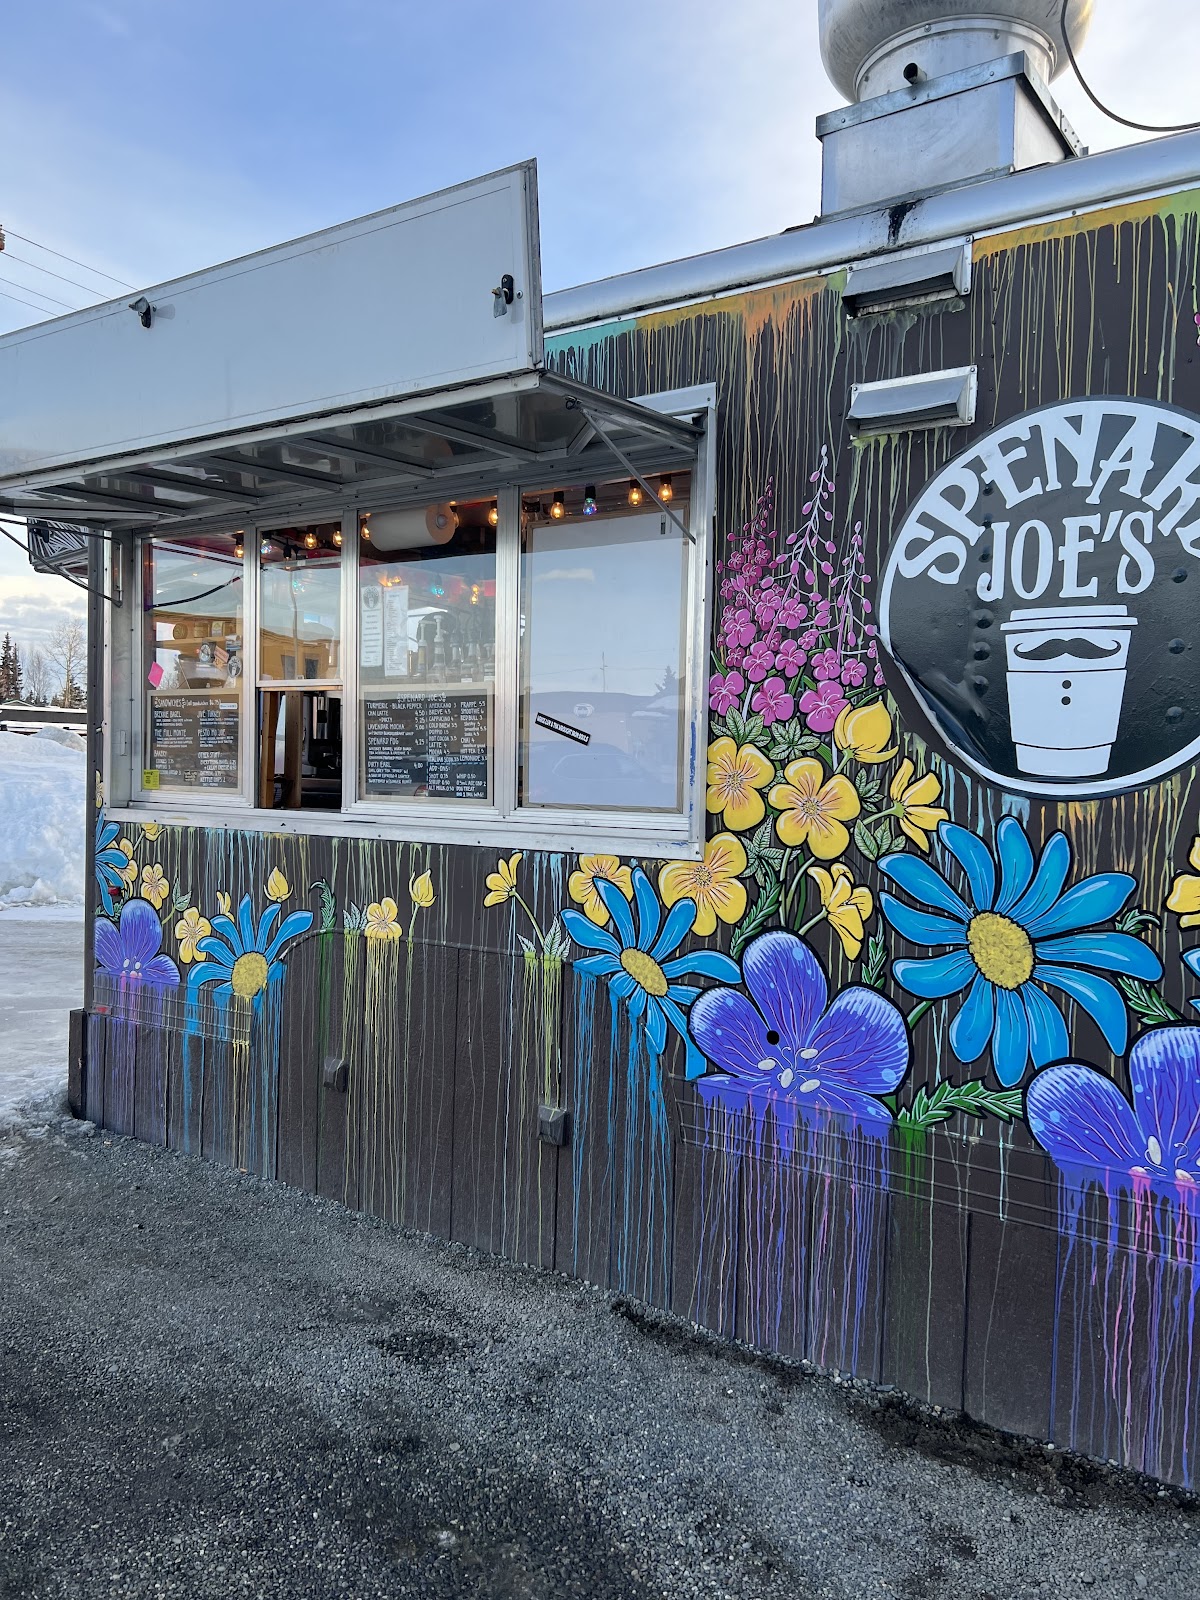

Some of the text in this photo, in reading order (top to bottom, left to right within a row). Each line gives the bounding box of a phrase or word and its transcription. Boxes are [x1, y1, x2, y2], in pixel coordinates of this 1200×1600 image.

[898, 413, 1200, 585] SPENAR
[976, 510, 1156, 602] JOE'S
[158, 699, 181, 707] SANDWICHES
[401, 693, 443, 702] SPENARD JOE'S
